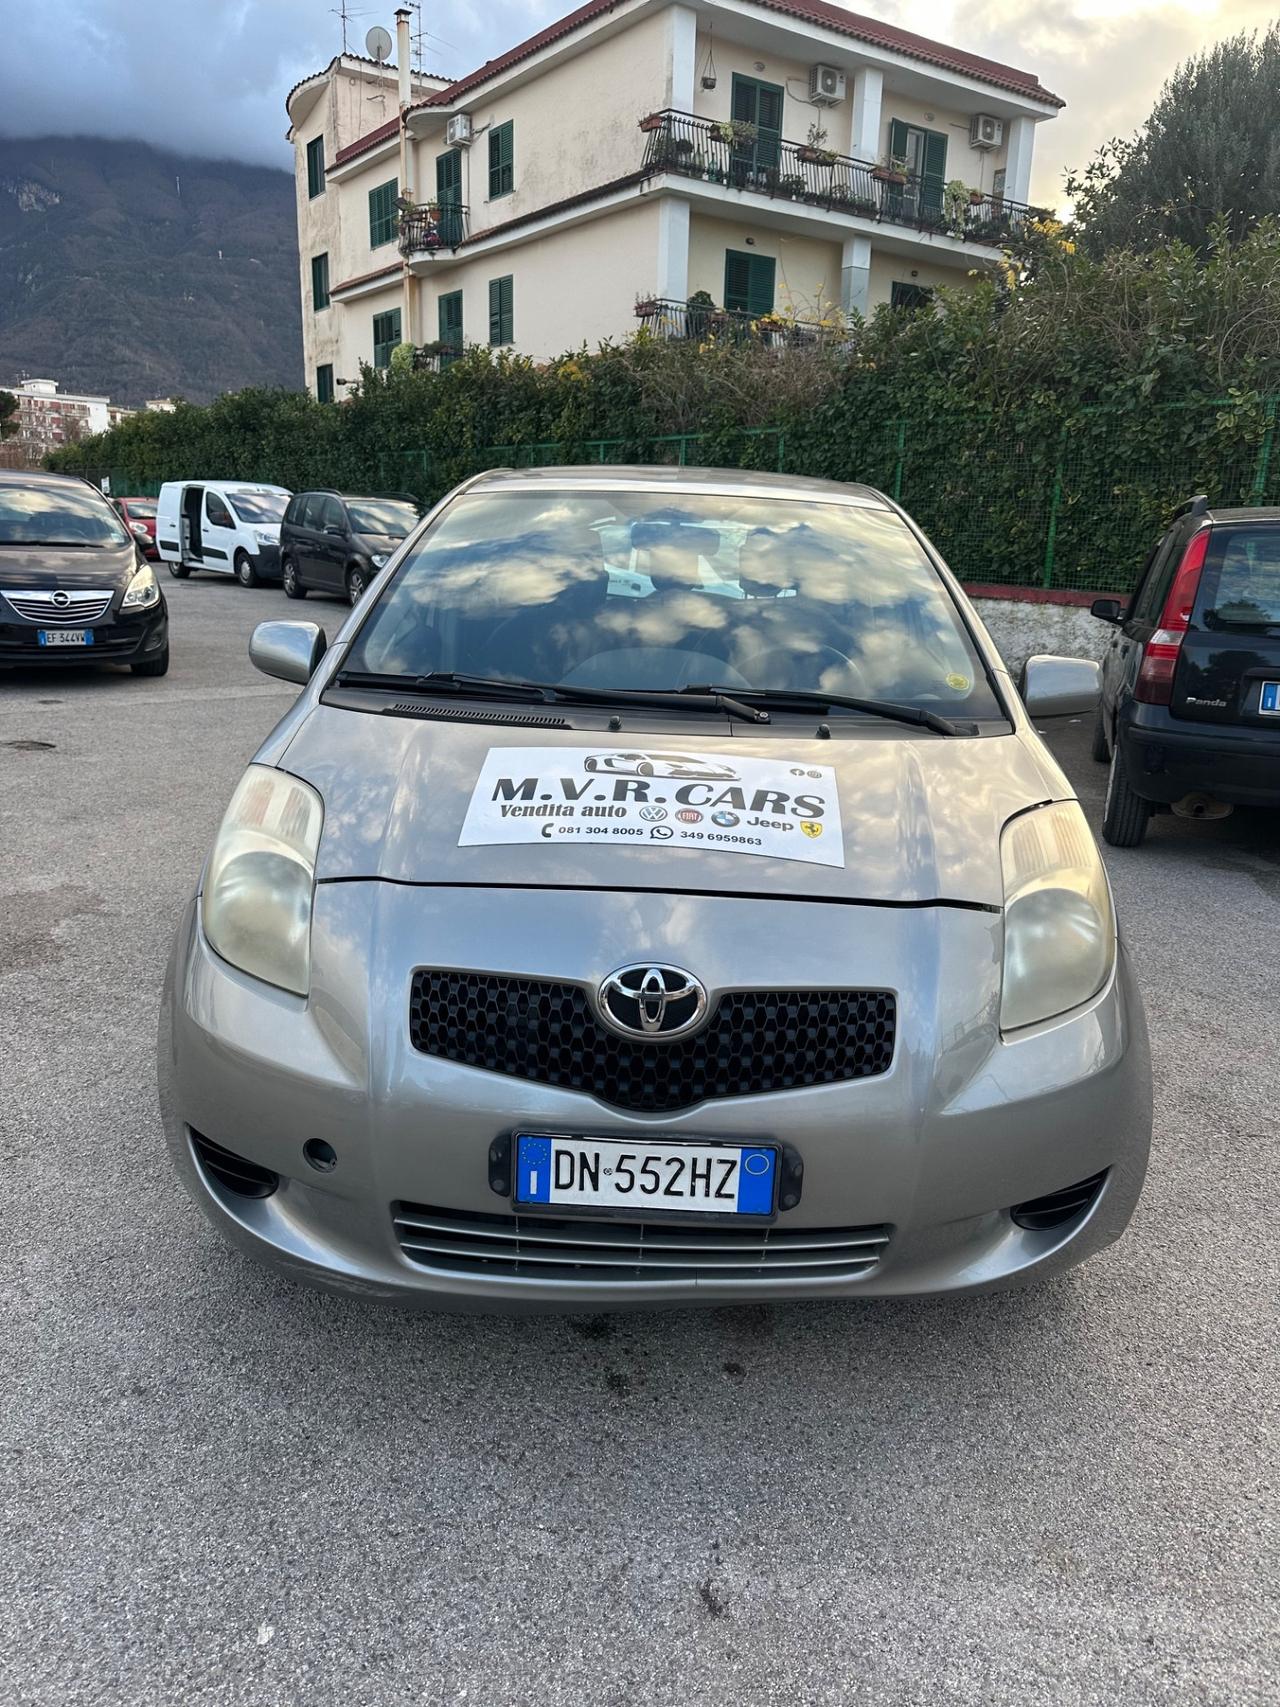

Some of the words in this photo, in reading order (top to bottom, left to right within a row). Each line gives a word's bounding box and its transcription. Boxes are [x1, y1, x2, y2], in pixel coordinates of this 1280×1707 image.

[47, 633, 56, 643] EF
[1186, 697, 1227, 707] Panda
[500, 804, 575, 817] Vendita
[581, 805, 627, 817] auto
[558, 826, 581, 834] 081
[585, 827, 609, 835] 304
[612, 827, 644, 836] 8005
[747, 817, 794, 832] Jeep
[680, 830, 704, 840] 349
[707, 833, 762, 846] 6959863
[554, 1149, 600, 1192] DN
[614, 1154, 738, 1199] 552HZ
